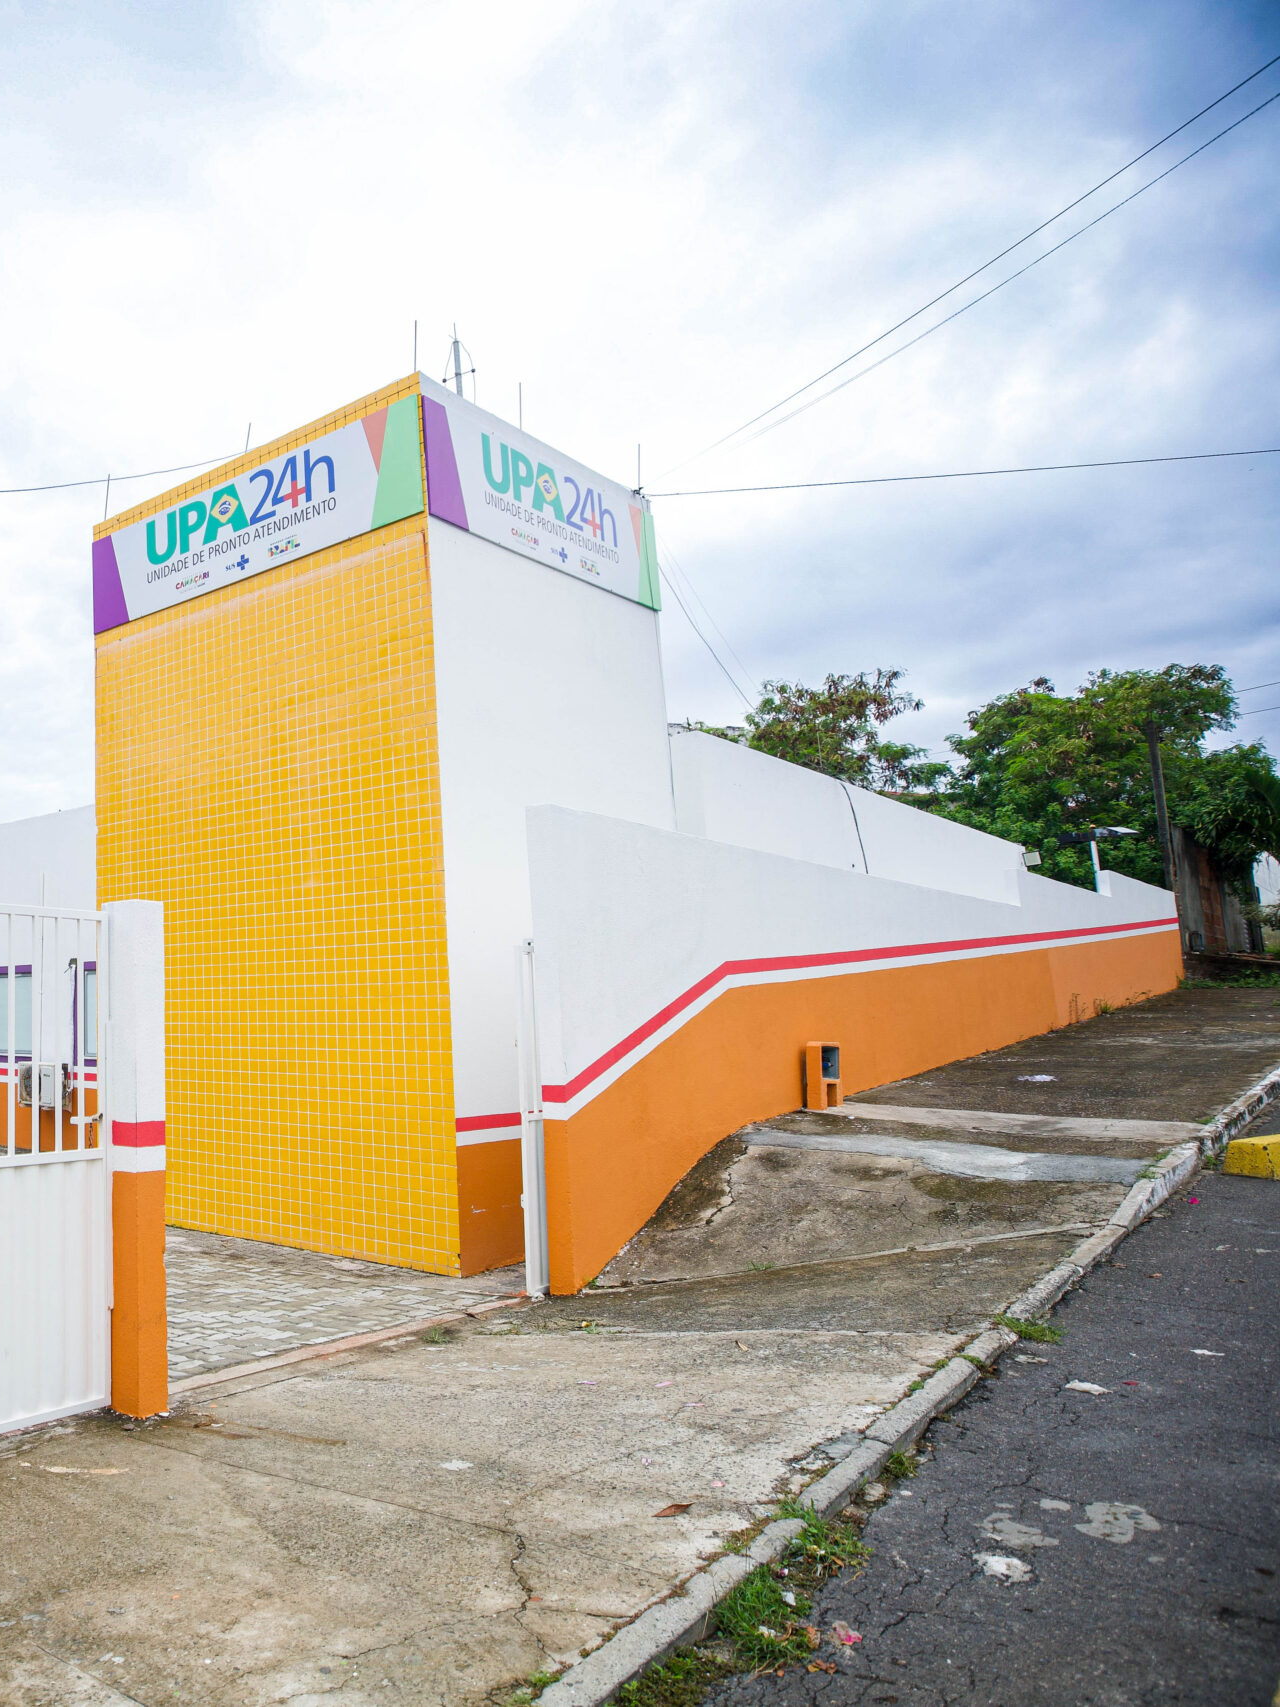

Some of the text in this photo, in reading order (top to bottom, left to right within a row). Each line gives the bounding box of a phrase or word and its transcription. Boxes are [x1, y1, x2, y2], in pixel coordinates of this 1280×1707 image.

[146, 449, 336, 565] UPA 24h
[146, 556, 189, 583] UNIDADE
[192, 553, 206, 566] DE
[208, 532, 251, 560] PRONTO
[253, 497, 337, 539] ATENDIMENTO
[481, 432, 618, 548] UPA 24h
[485, 490, 620, 564] UNIDADE DE PRONTO ATENDIMENTO
